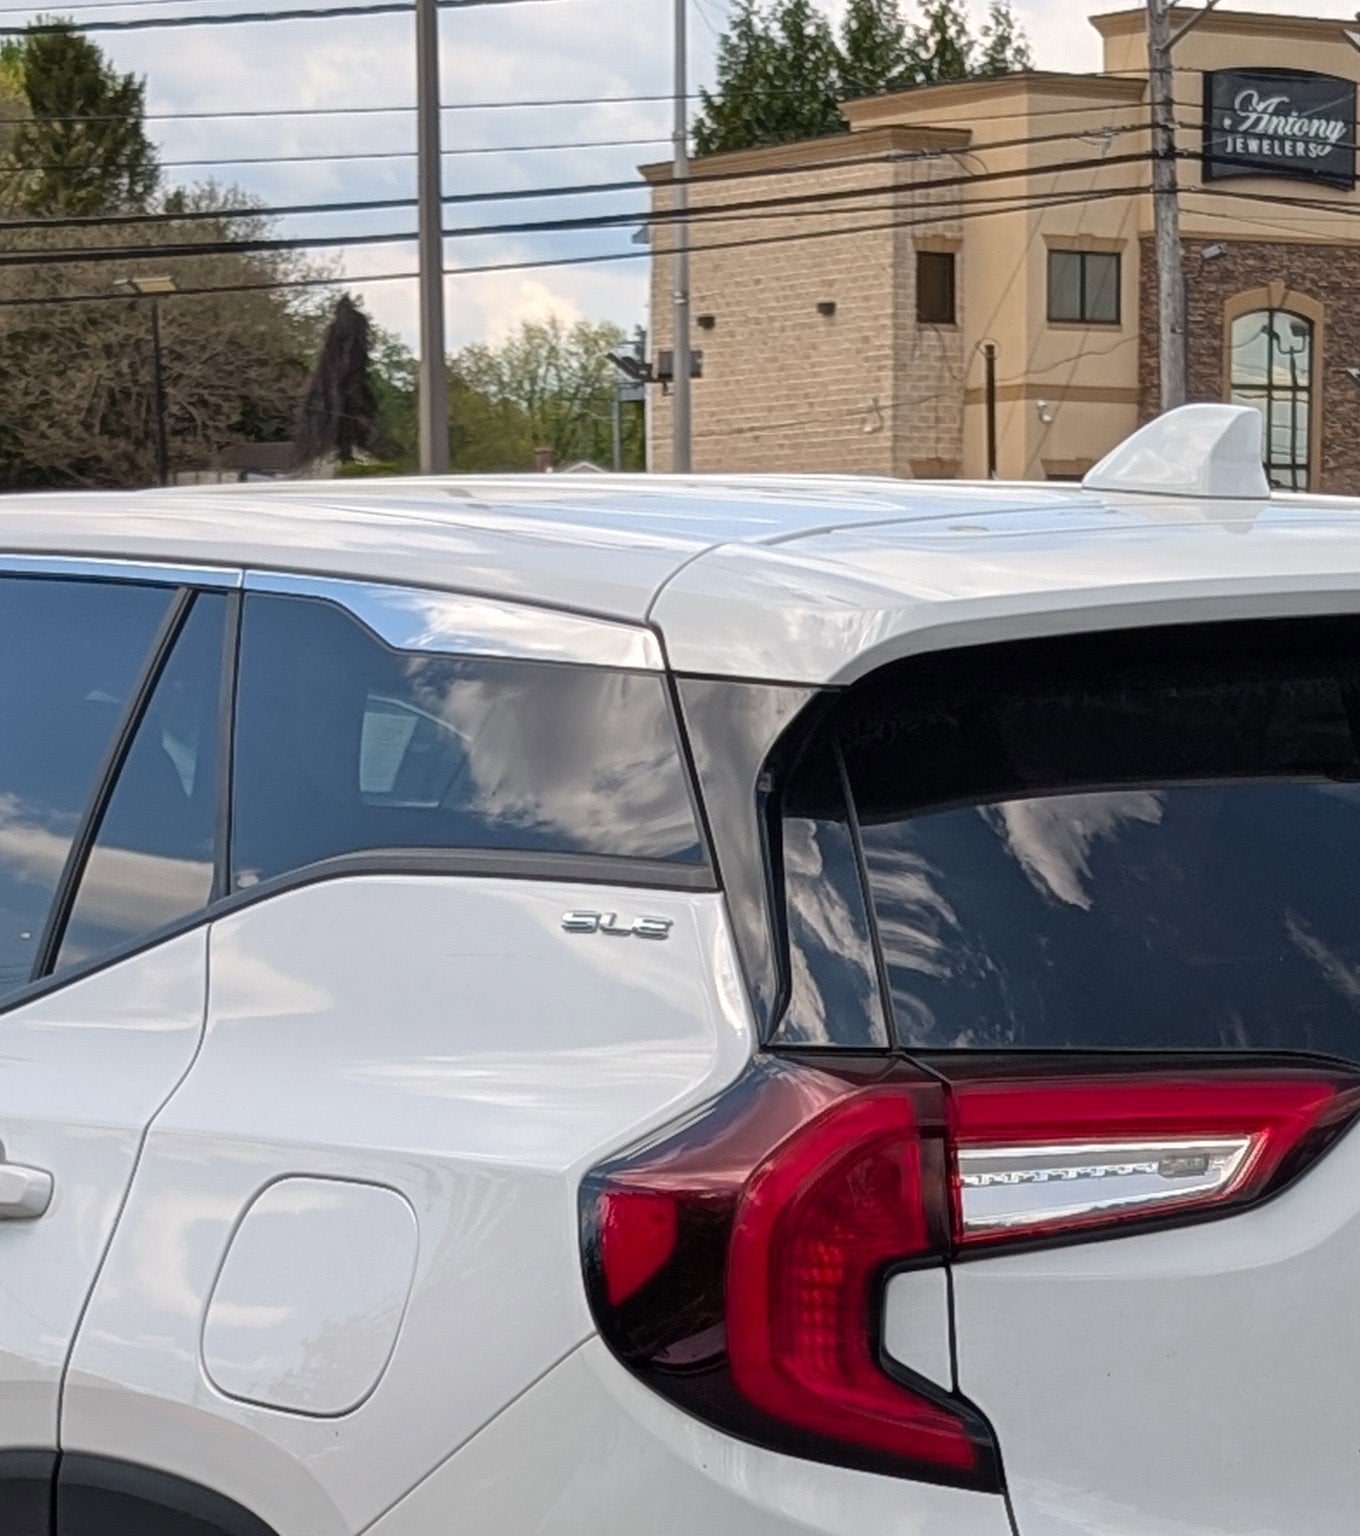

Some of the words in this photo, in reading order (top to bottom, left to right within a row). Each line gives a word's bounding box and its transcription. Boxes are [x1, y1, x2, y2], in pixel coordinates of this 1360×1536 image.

[1223, 89, 1347, 148] Antony
[1225, 136, 1319, 159] JEWELERS
[561, 909, 674, 941] SLE
